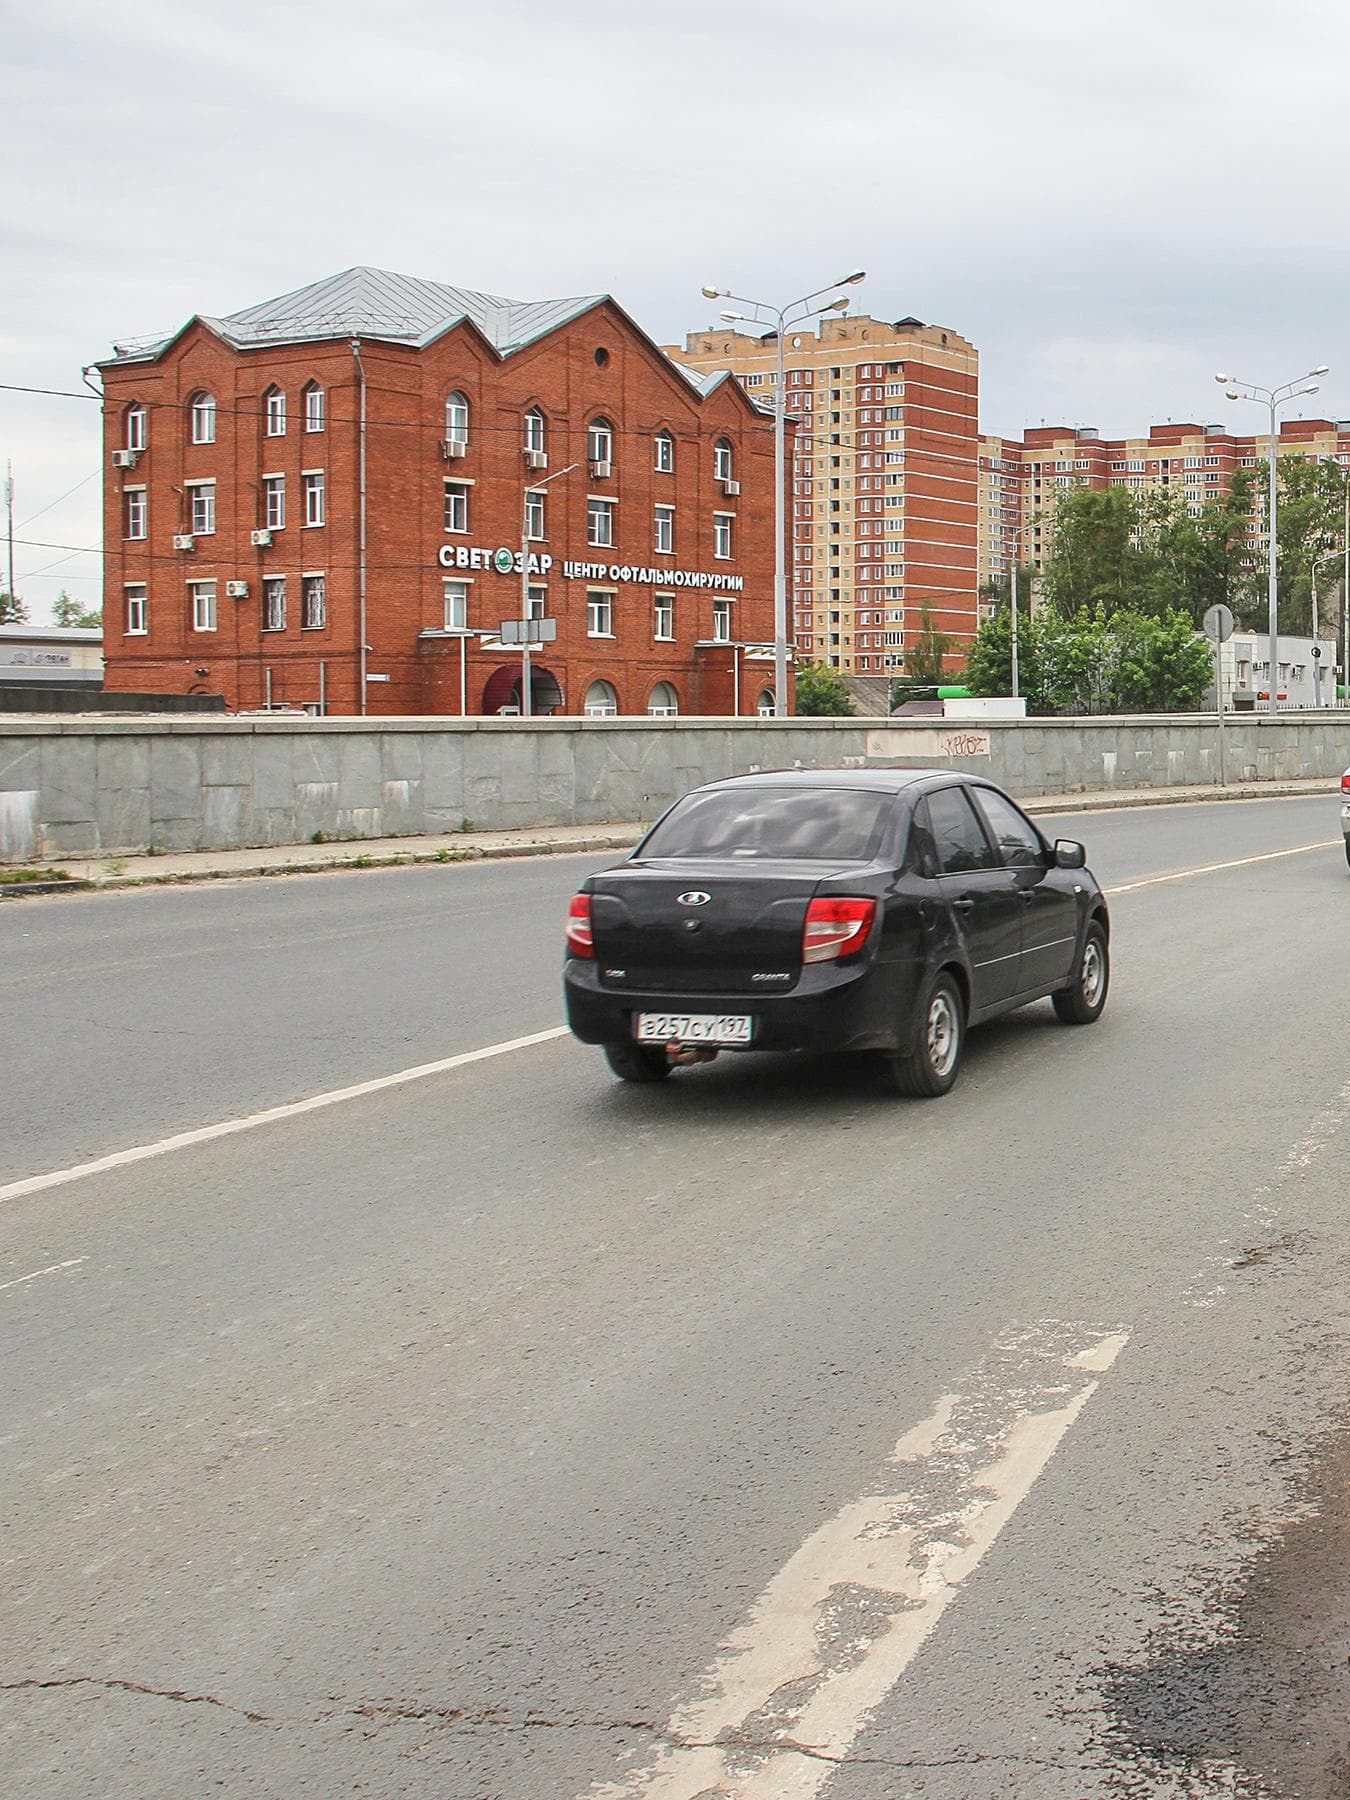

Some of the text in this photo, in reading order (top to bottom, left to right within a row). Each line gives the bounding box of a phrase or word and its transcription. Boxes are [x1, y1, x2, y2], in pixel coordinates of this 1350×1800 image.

[439, 544, 553, 575] СВЕТОЗАР
[564, 561, 744, 590] ЦЕНТР ОФТАЛЬМОХИРУРГИИ
